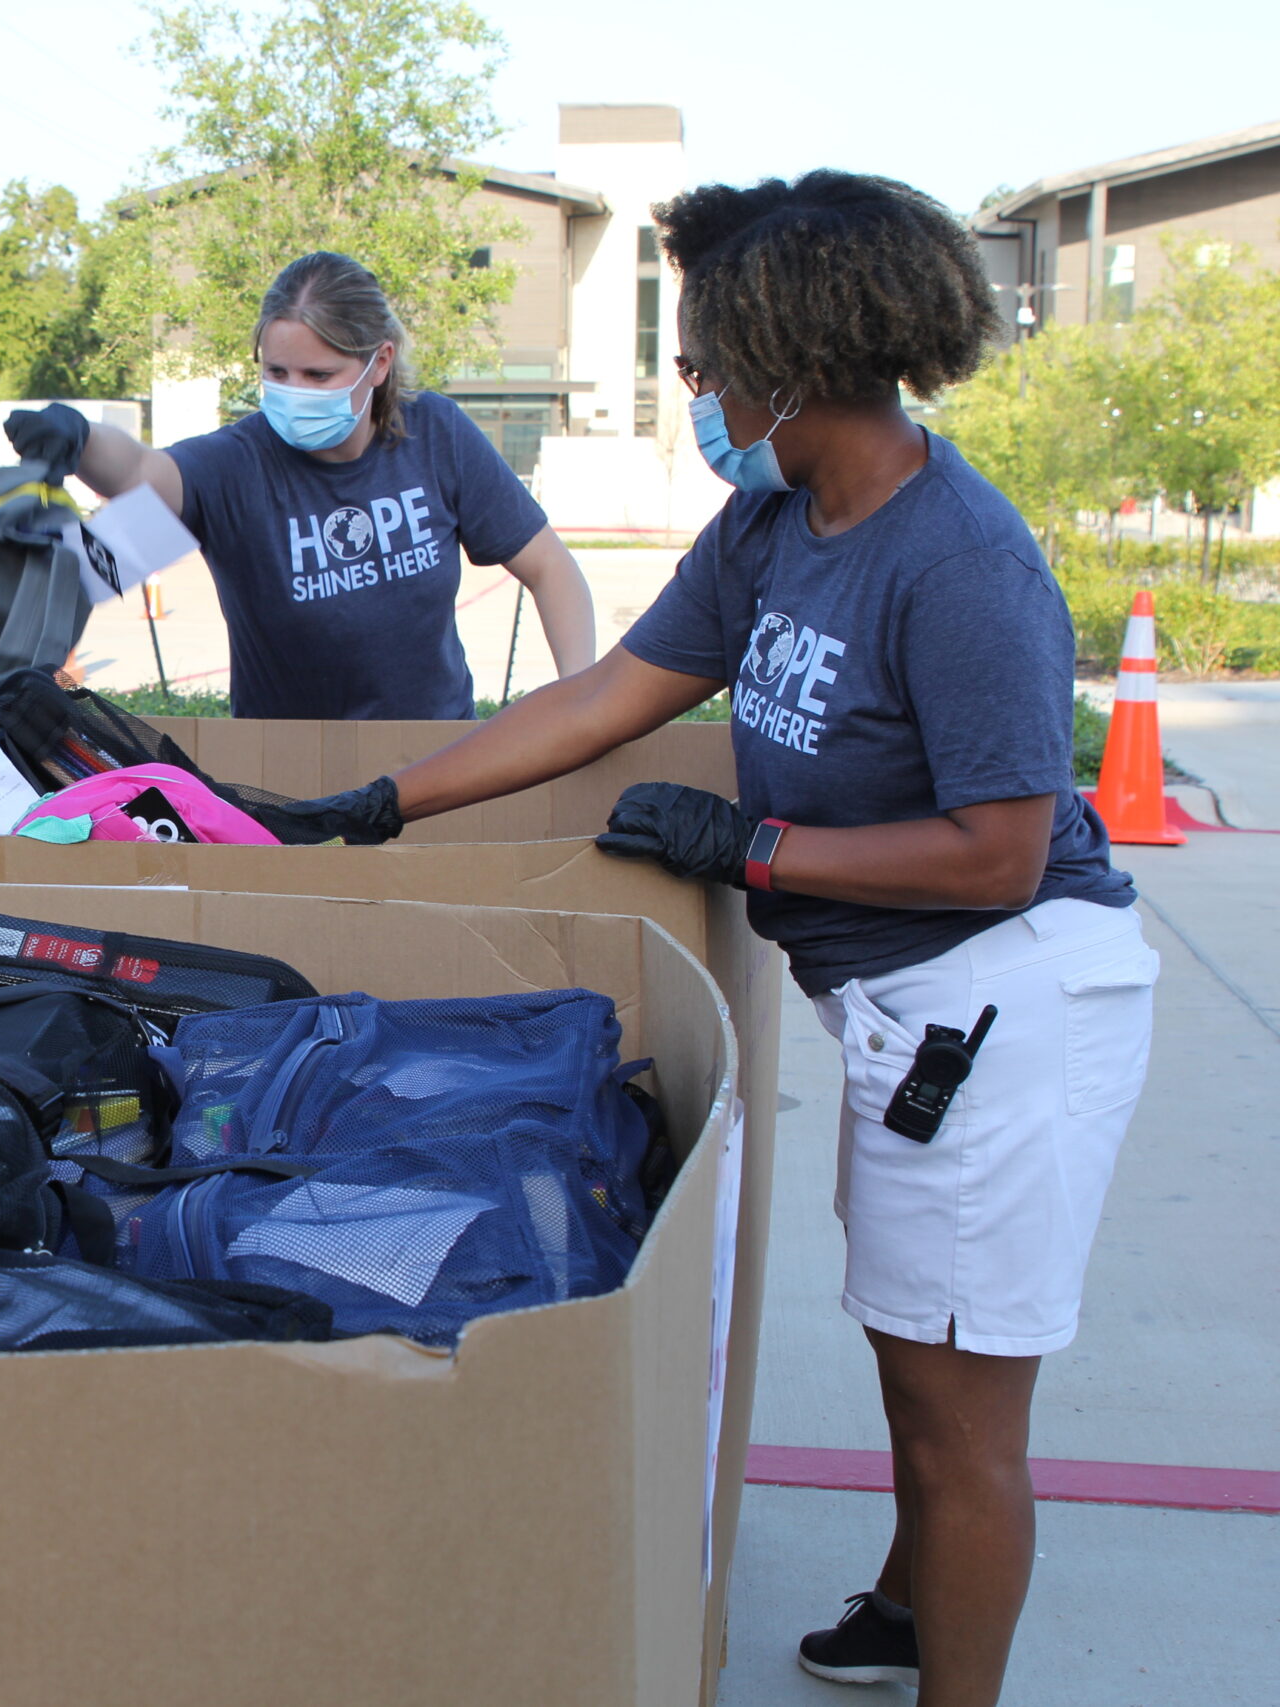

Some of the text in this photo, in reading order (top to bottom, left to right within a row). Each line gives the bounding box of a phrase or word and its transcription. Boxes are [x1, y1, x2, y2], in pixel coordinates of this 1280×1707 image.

[292, 542, 440, 602] SHINES HERE
[761, 701, 822, 755] HERE
